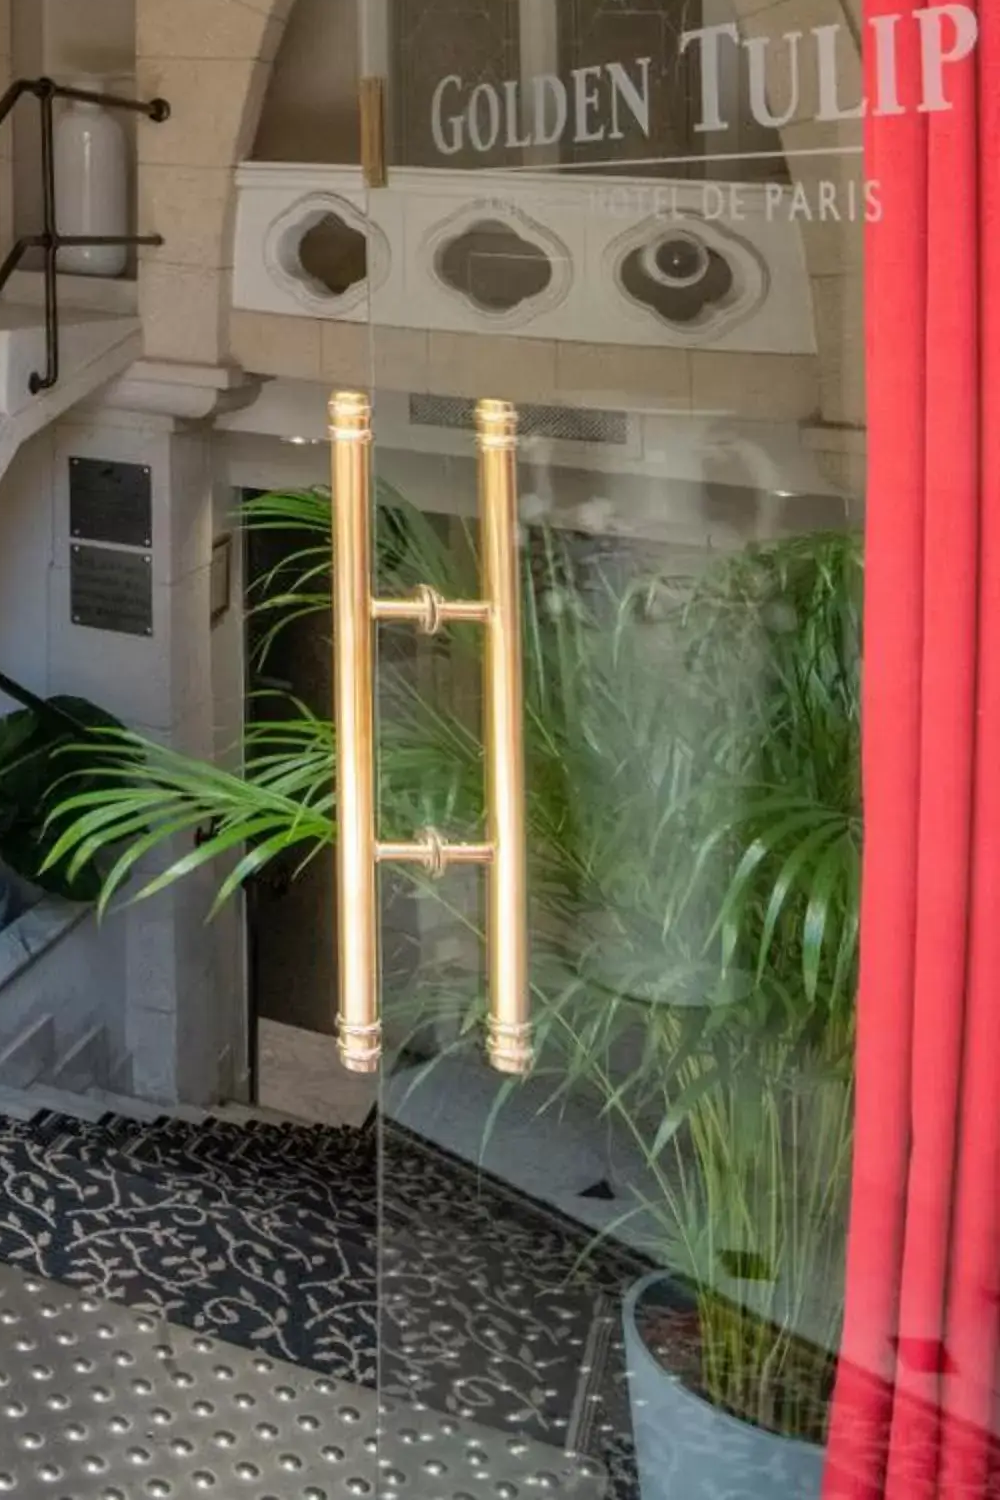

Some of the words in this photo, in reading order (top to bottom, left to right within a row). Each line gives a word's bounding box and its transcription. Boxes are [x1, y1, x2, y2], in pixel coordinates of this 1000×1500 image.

[430, 57, 652, 156] GOLDEN
[679, 3, 980, 135] TULIP
[702, 181, 745, 223] DE
[765, 178, 884, 223] PARIS
